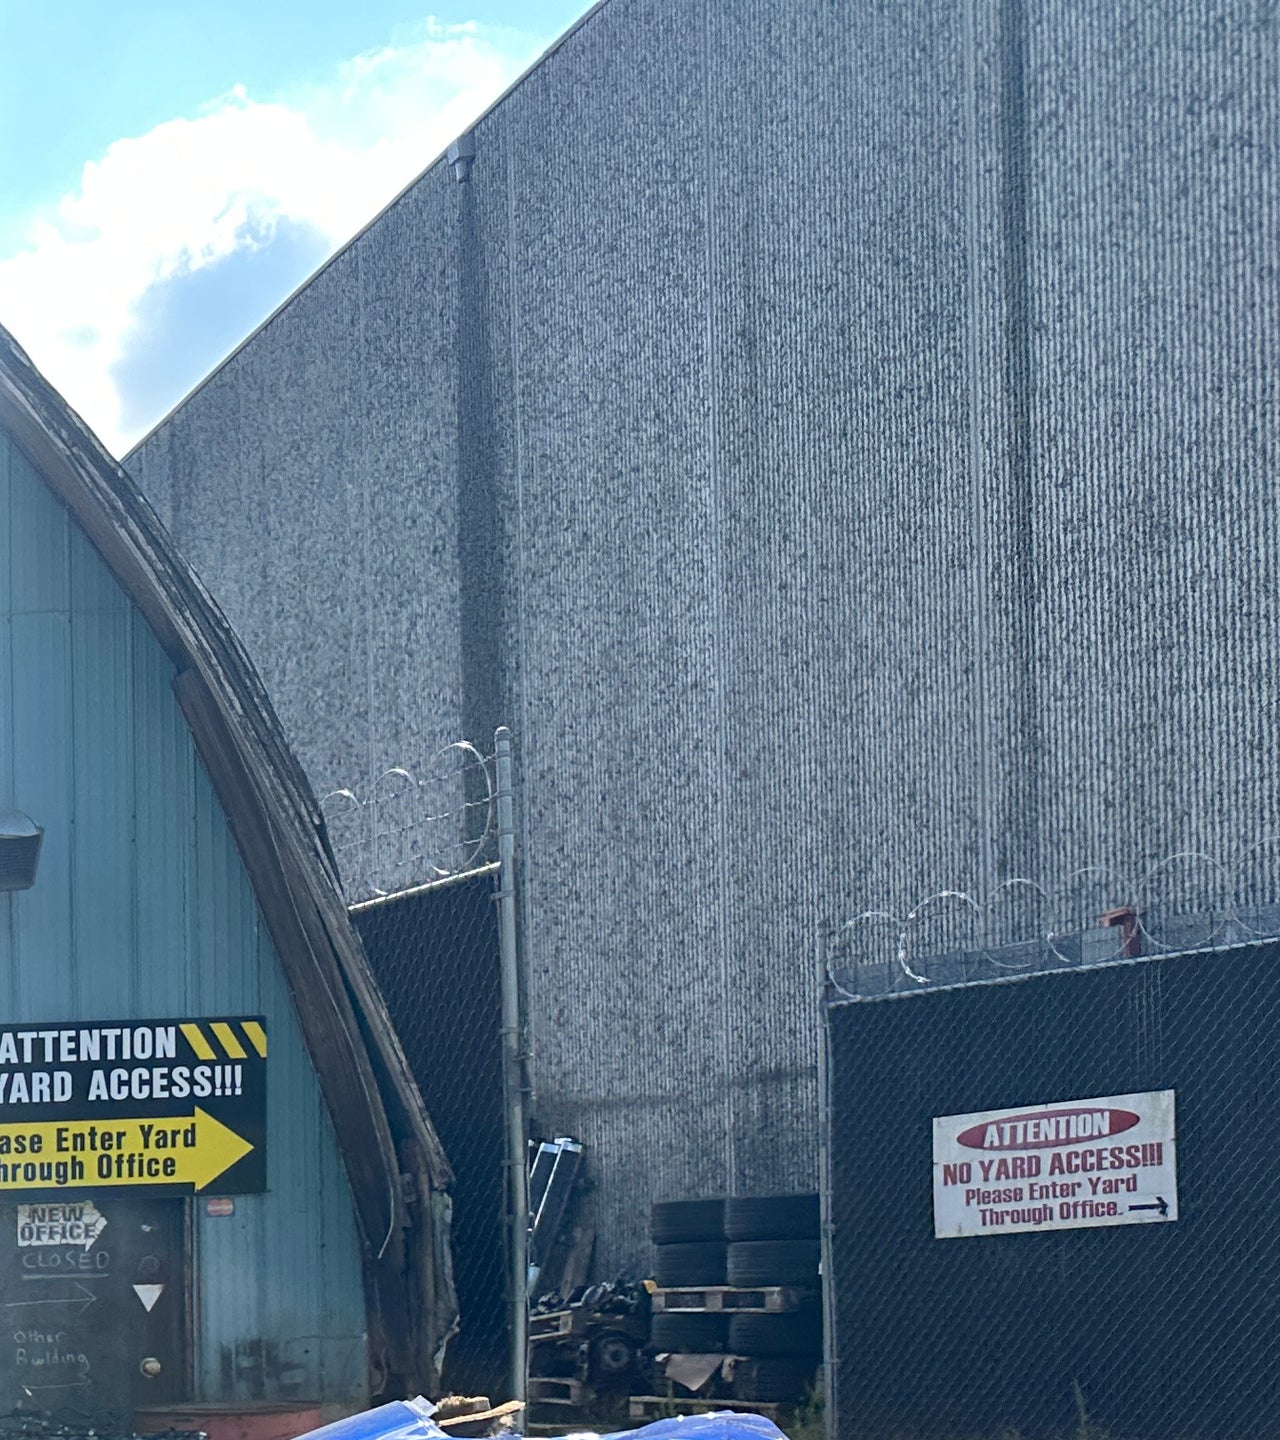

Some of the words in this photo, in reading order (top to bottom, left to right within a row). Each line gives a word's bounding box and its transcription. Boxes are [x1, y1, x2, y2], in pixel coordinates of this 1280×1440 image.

[89, 1065, 242, 1100] ACCESS!!!
[57, 1126, 127, 1152] Enter
[140, 1123, 196, 1150] Yard
[983, 1111, 1110, 1148] ATTENTION
[98, 1153, 176, 1179] Office
[943, 1162, 971, 1186] NO
[979, 1155, 1041, 1182] YARD
[1049, 1142, 1163, 1176] ACCESS!!!
[966, 1187, 1023, 1206] Please
[1029, 1180, 1082, 1201] Enter
[1088, 1174, 1137, 1196] Yard
[29, 1206, 85, 1222] NEW
[979, 1203, 1054, 1226] Through
[20, 1222, 97, 1241] OFFICE
[22, 1251, 110, 1270] CLOSED
